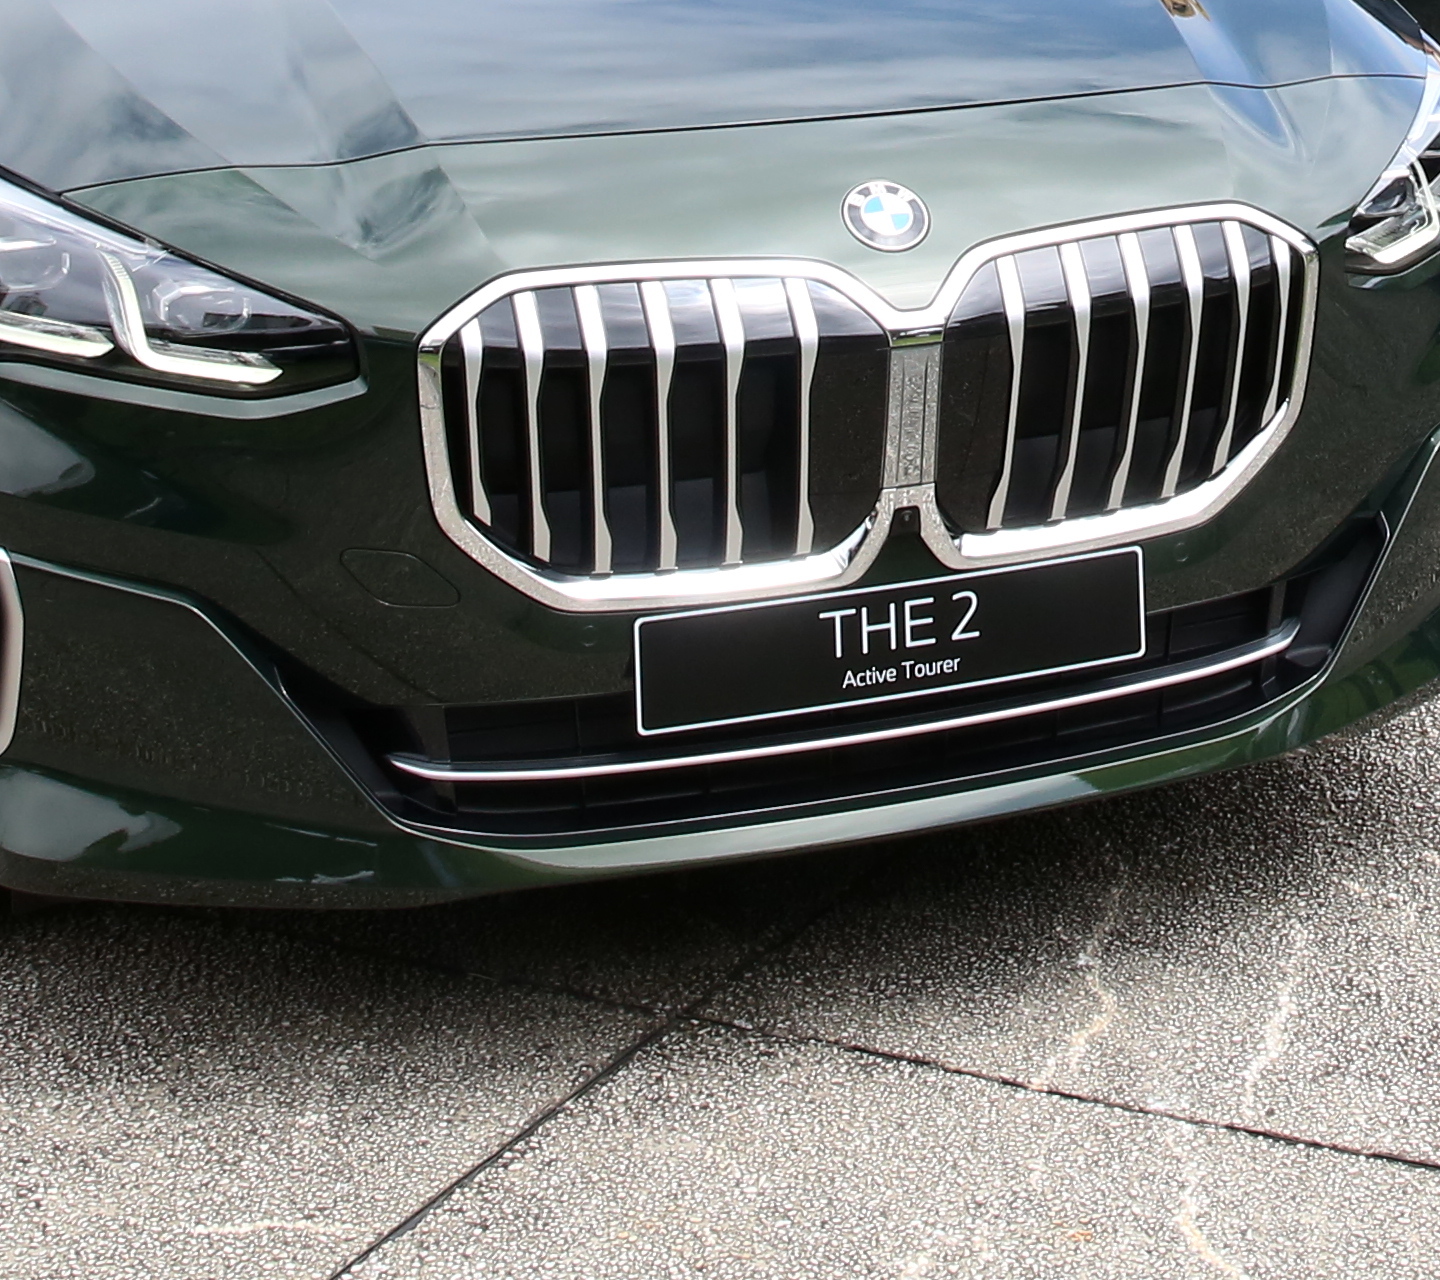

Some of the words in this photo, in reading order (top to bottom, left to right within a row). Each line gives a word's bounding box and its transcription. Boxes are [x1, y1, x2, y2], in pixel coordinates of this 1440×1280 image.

[846, 182, 917, 208] BMW
[818, 596, 937, 659] THE
[951, 590, 981, 641] 2
[842, 666, 897, 689] Active
[900, 657, 961, 679] Tourer
